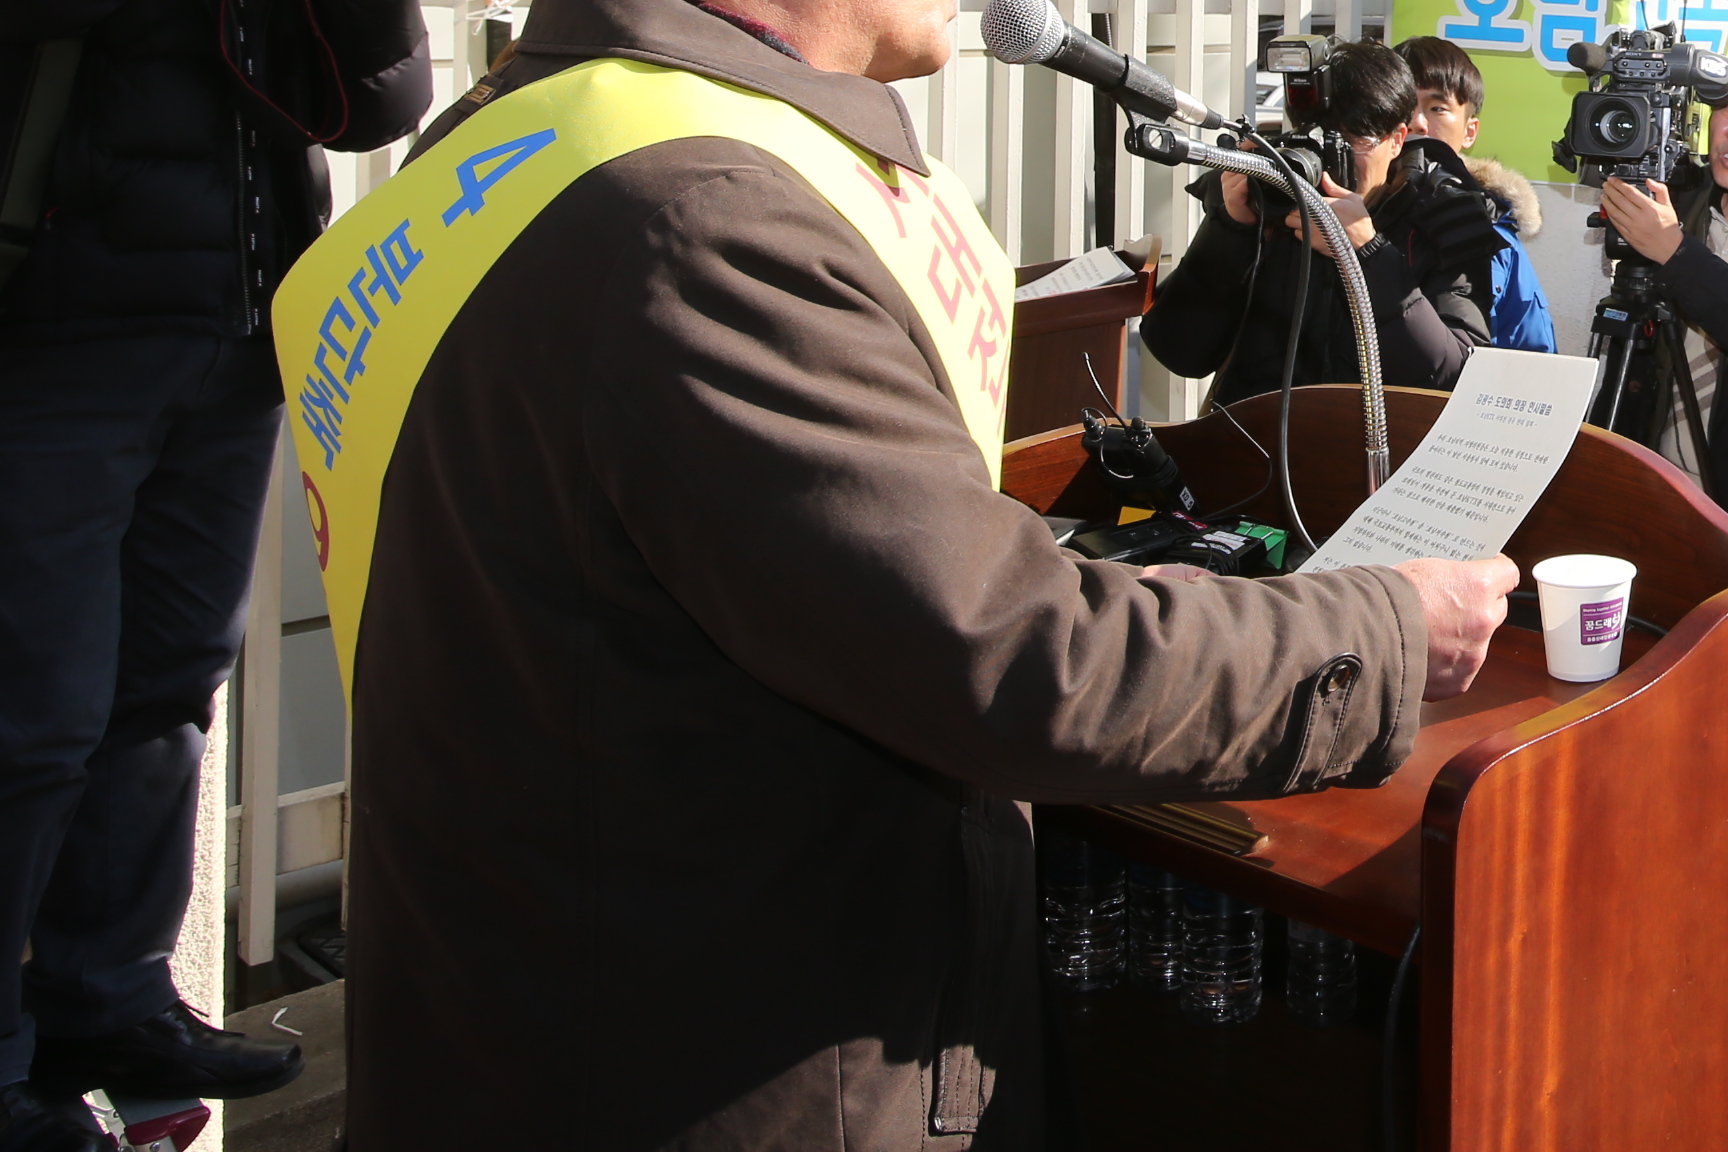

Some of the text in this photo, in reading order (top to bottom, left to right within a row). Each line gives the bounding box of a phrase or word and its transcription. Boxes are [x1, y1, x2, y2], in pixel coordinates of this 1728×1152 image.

[1700, 56, 1727, 77] KBS
[1513, 399, 1527, 411] 의장
[1527, 401, 1553, 416] 인사말씀
